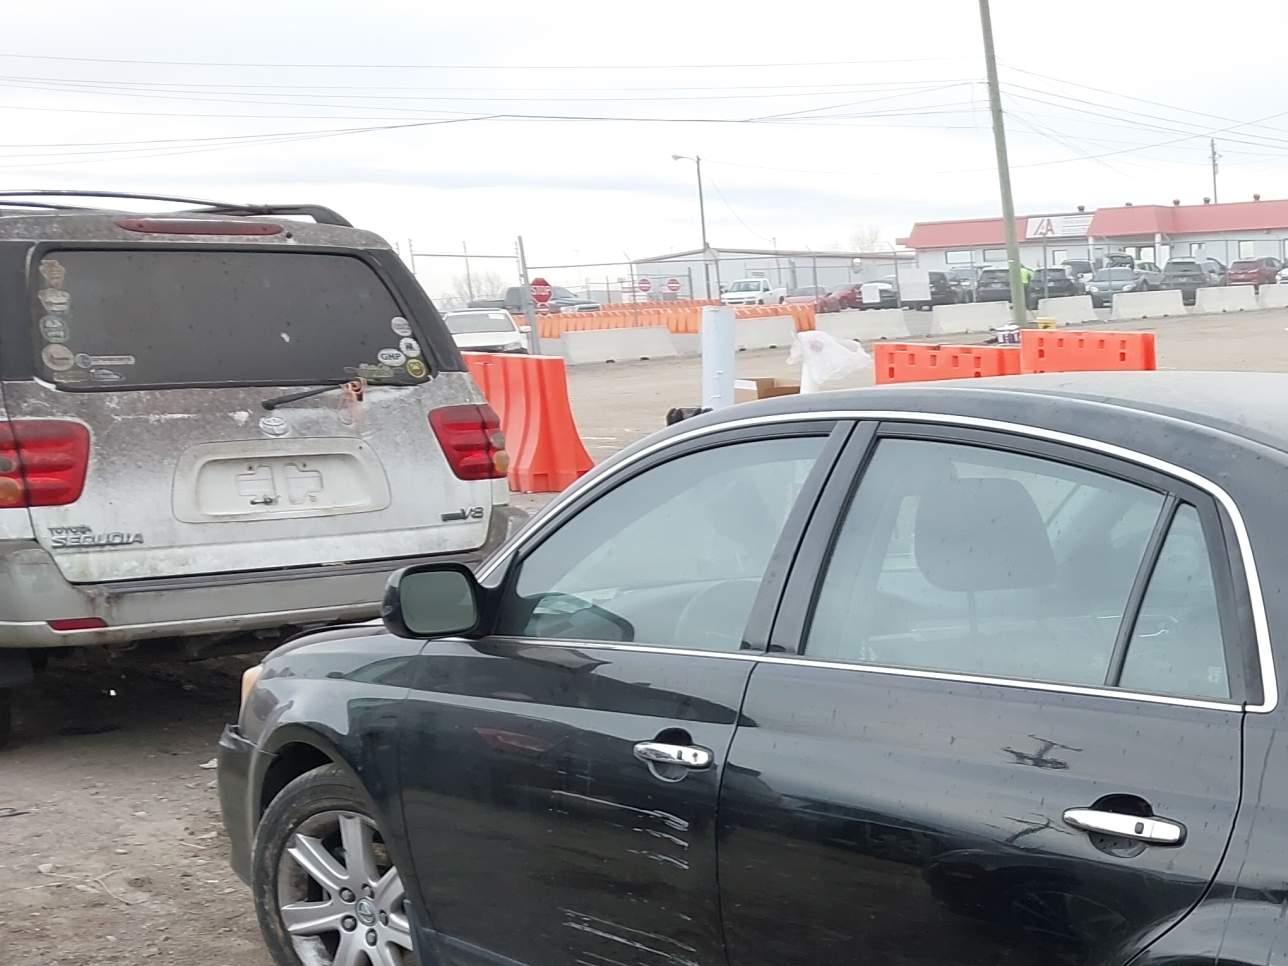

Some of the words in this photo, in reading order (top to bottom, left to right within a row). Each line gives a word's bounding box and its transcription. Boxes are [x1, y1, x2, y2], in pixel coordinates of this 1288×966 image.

[530, 285, 553, 297] STOP
[460, 506, 485, 520] V8
[51, 532, 145, 549] SEQUOIA
